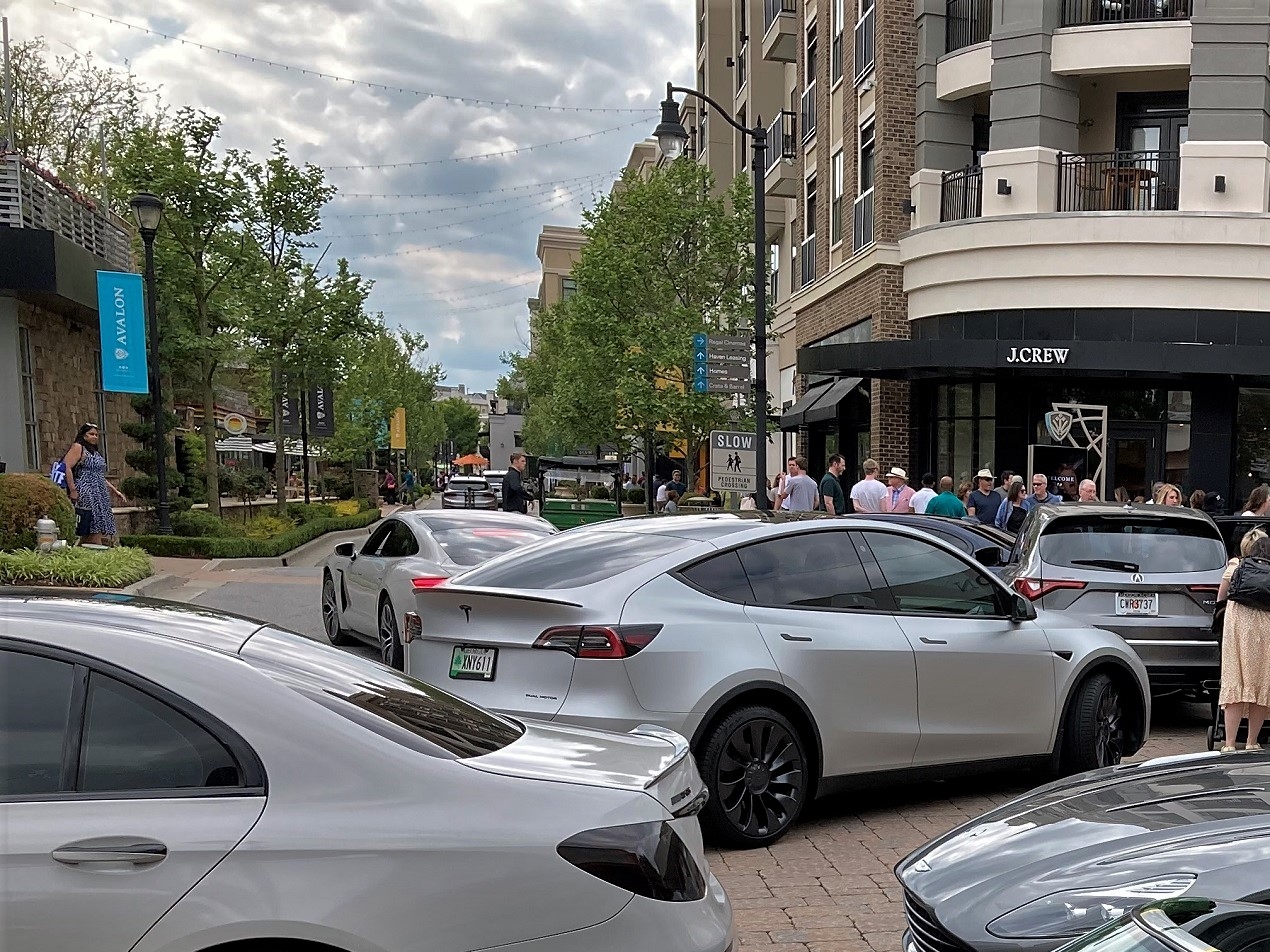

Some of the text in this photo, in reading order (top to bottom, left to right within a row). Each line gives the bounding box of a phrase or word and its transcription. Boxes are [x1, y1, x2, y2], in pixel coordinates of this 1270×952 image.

[113, 286, 127, 346] AVALON
[726, 354, 747, 362] Leasing
[1006, 347, 1070, 364] J.CREW
[717, 434, 752, 448] SLOW
